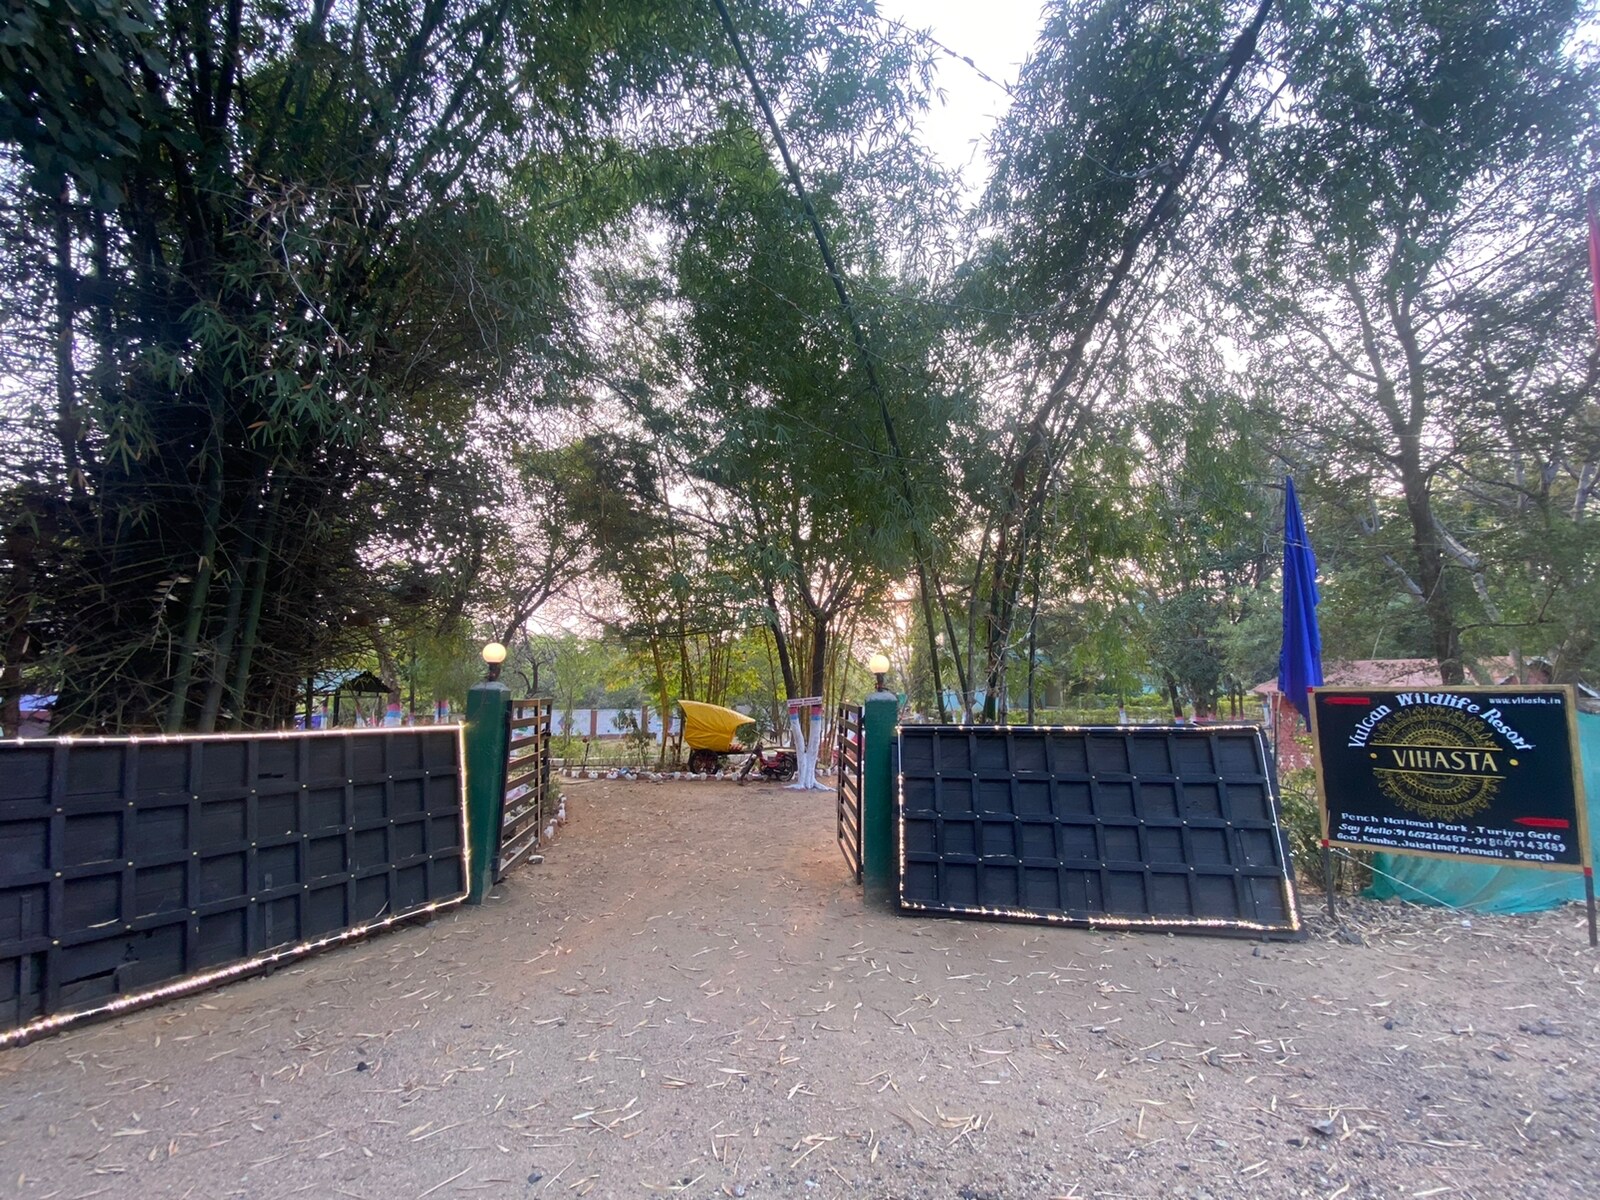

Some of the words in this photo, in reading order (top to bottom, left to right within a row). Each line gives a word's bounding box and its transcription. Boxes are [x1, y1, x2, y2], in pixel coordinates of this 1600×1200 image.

[1348, 705, 1392, 748] Vulcan
[1395, 692, 1480, 713] Wildlife
[1479, 707, 1537, 750] Resort
[1392, 749, 1498, 772] VIHASTA
[1338, 823, 1361, 835] Say
[1341, 812, 1379, 823] Pench
[1383, 816, 1434, 829] National
[1476, 826, 1525, 840] Turiya
[1527, 830, 1562, 841] Gate
[1514, 850, 1556, 861] Pench
